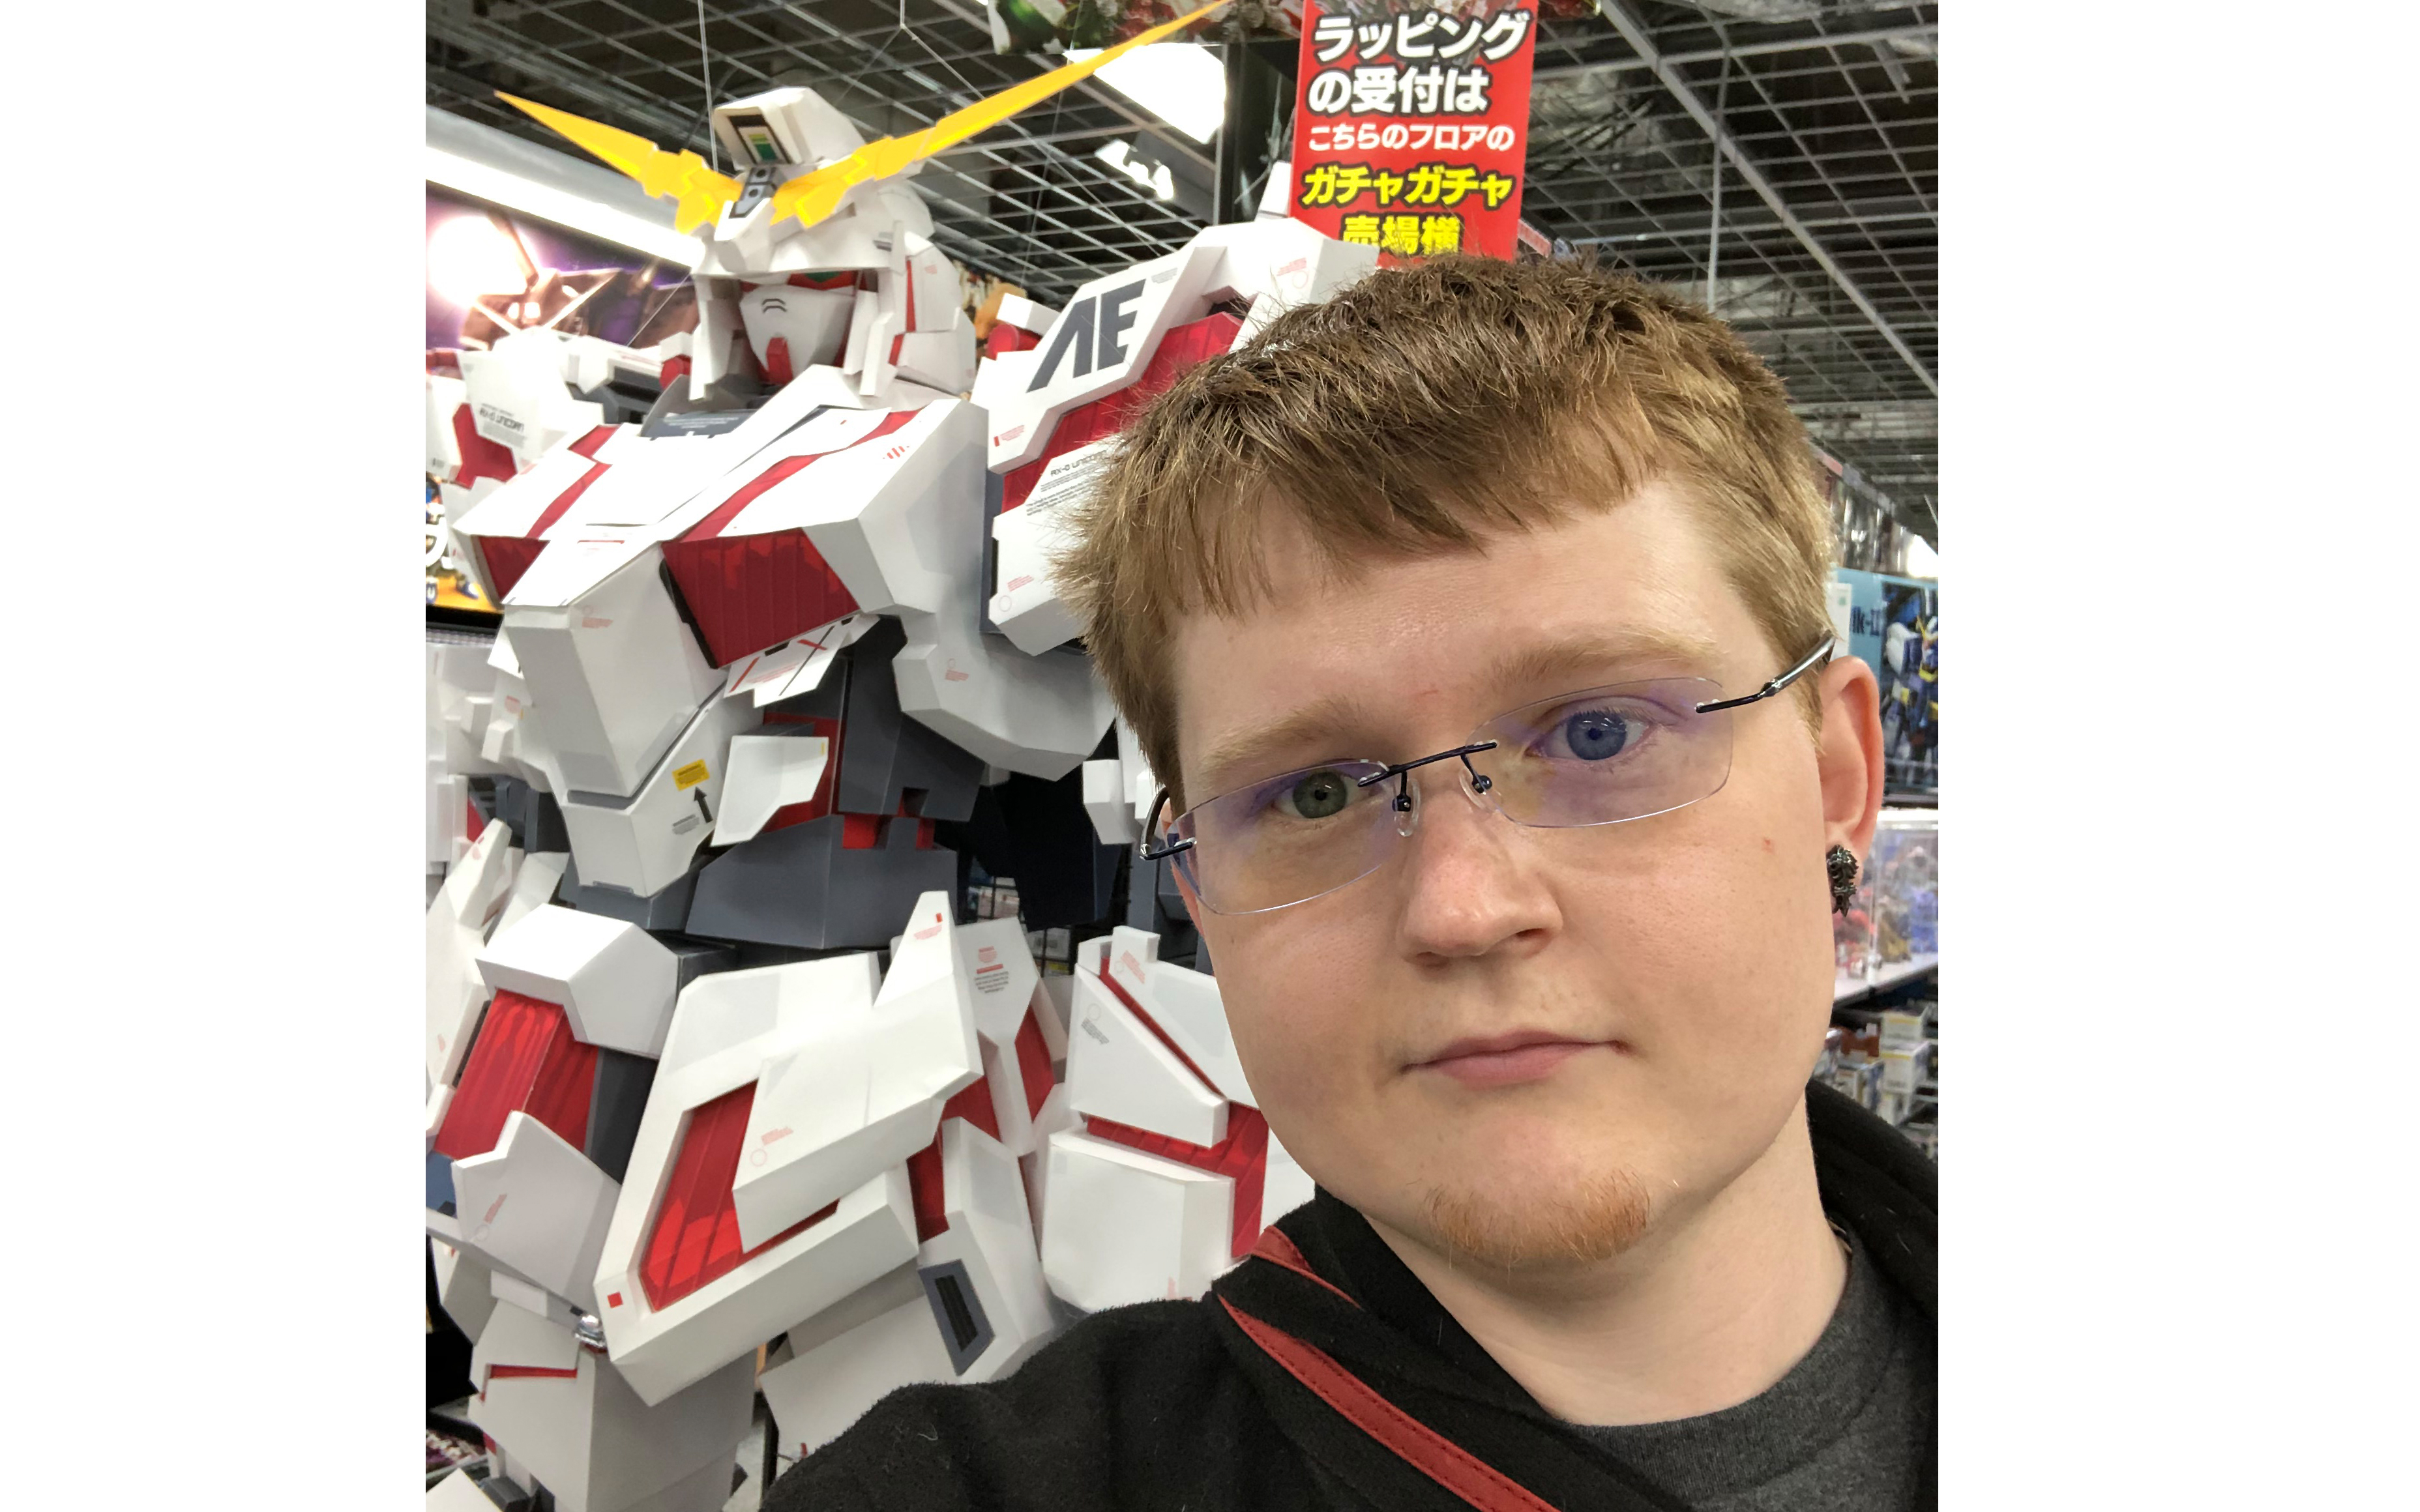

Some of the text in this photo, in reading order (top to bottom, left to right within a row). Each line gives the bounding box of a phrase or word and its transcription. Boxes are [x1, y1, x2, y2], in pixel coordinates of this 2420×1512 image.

[1314, 10, 1530, 61] ラッピング
[1309, 66, 1489, 113] の受付は
[1308, 123, 1515, 151] こちらのフロアの
[1302, 165, 1512, 207] ガチャガチャ
[1026, 278, 1146, 394] AE
